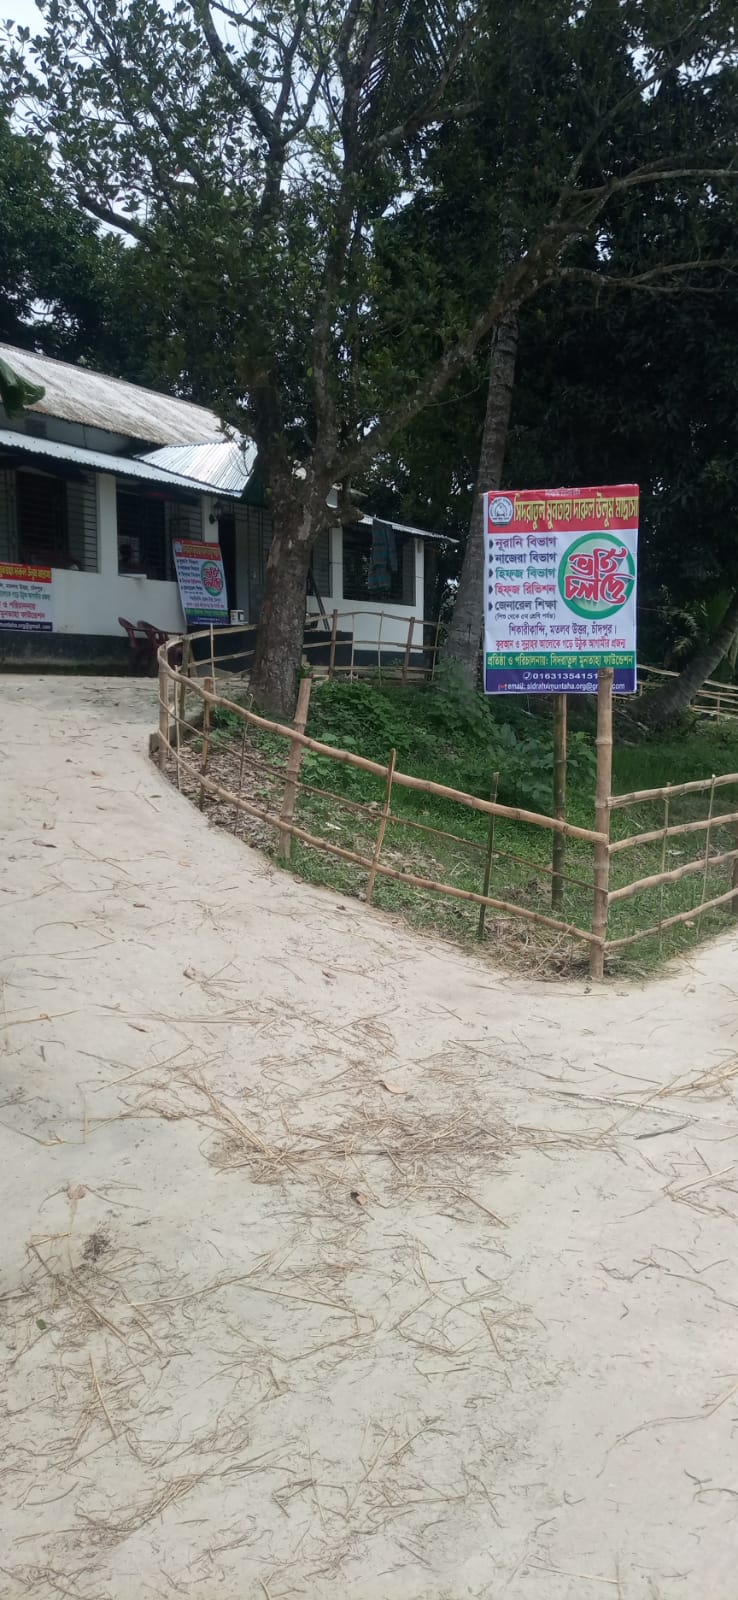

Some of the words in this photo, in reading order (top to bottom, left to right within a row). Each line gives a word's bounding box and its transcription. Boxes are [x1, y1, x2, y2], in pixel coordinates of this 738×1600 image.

[514, 493, 545, 530] সিদরাতুল
[546, 499, 572, 529] মুনতাহা
[573, 498, 594, 520] দারুল
[595, 492, 614, 527] উলুম
[494, 535, 523, 552] নূরানি
[526, 534, 557, 548] বিভাগ
[494, 553, 526, 564] নাজেরা
[528, 550, 557, 563] বিভাগ
[568, 546, 628, 578] ভর্তি
[526, 565, 557, 579] বিভাগ
[522, 581, 556, 596] রিভিশন
[564, 572, 635, 605] চলছে
[494, 600, 532, 611] জেনারেল
[534, 596, 557, 611] শিক্ষা
[550, 624, 570, 635] মতলব
[515, 640, 520, 648] ও
[508, 656, 513, 665] ও
[532, 672, 598, 680] 01631354151
